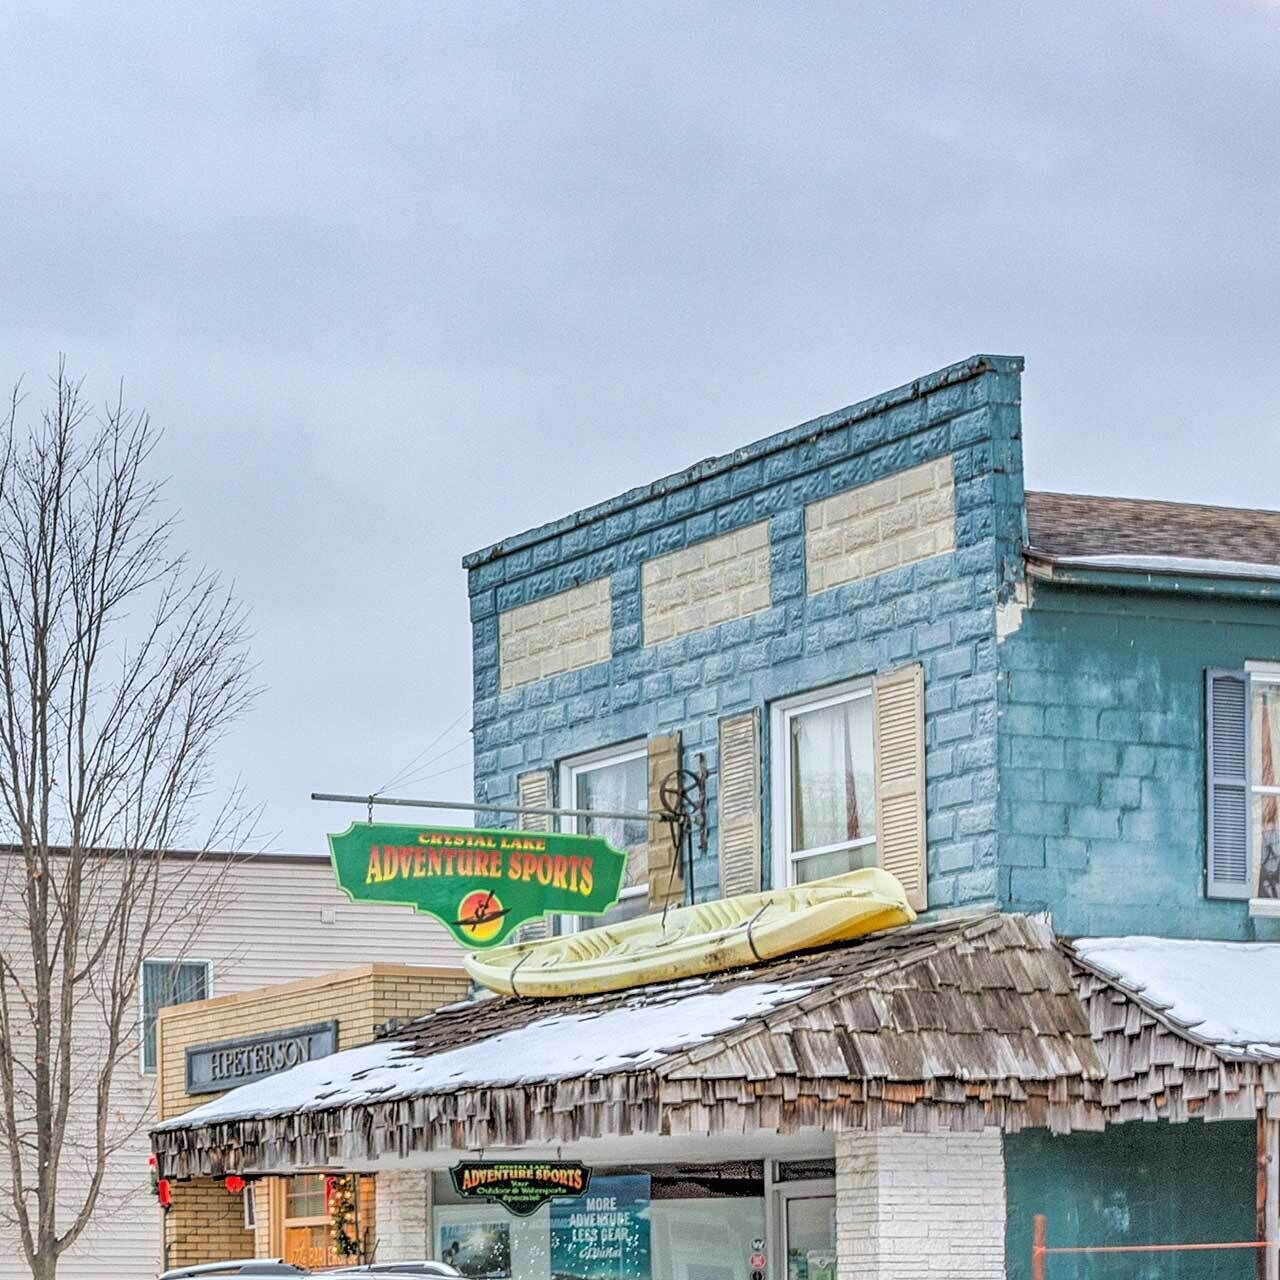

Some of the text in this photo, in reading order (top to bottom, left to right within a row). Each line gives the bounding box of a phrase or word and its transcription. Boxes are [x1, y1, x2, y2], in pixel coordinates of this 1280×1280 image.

[418, 833, 546, 850] CRYSTAL LAKE
[366, 845, 594, 896] ADVENTURE SPORTS
[462, 1168, 582, 1190] ADVENTURE SPORTS
[586, 1197, 617, 1211] MORE
[572, 1228, 598, 1242] LESS
